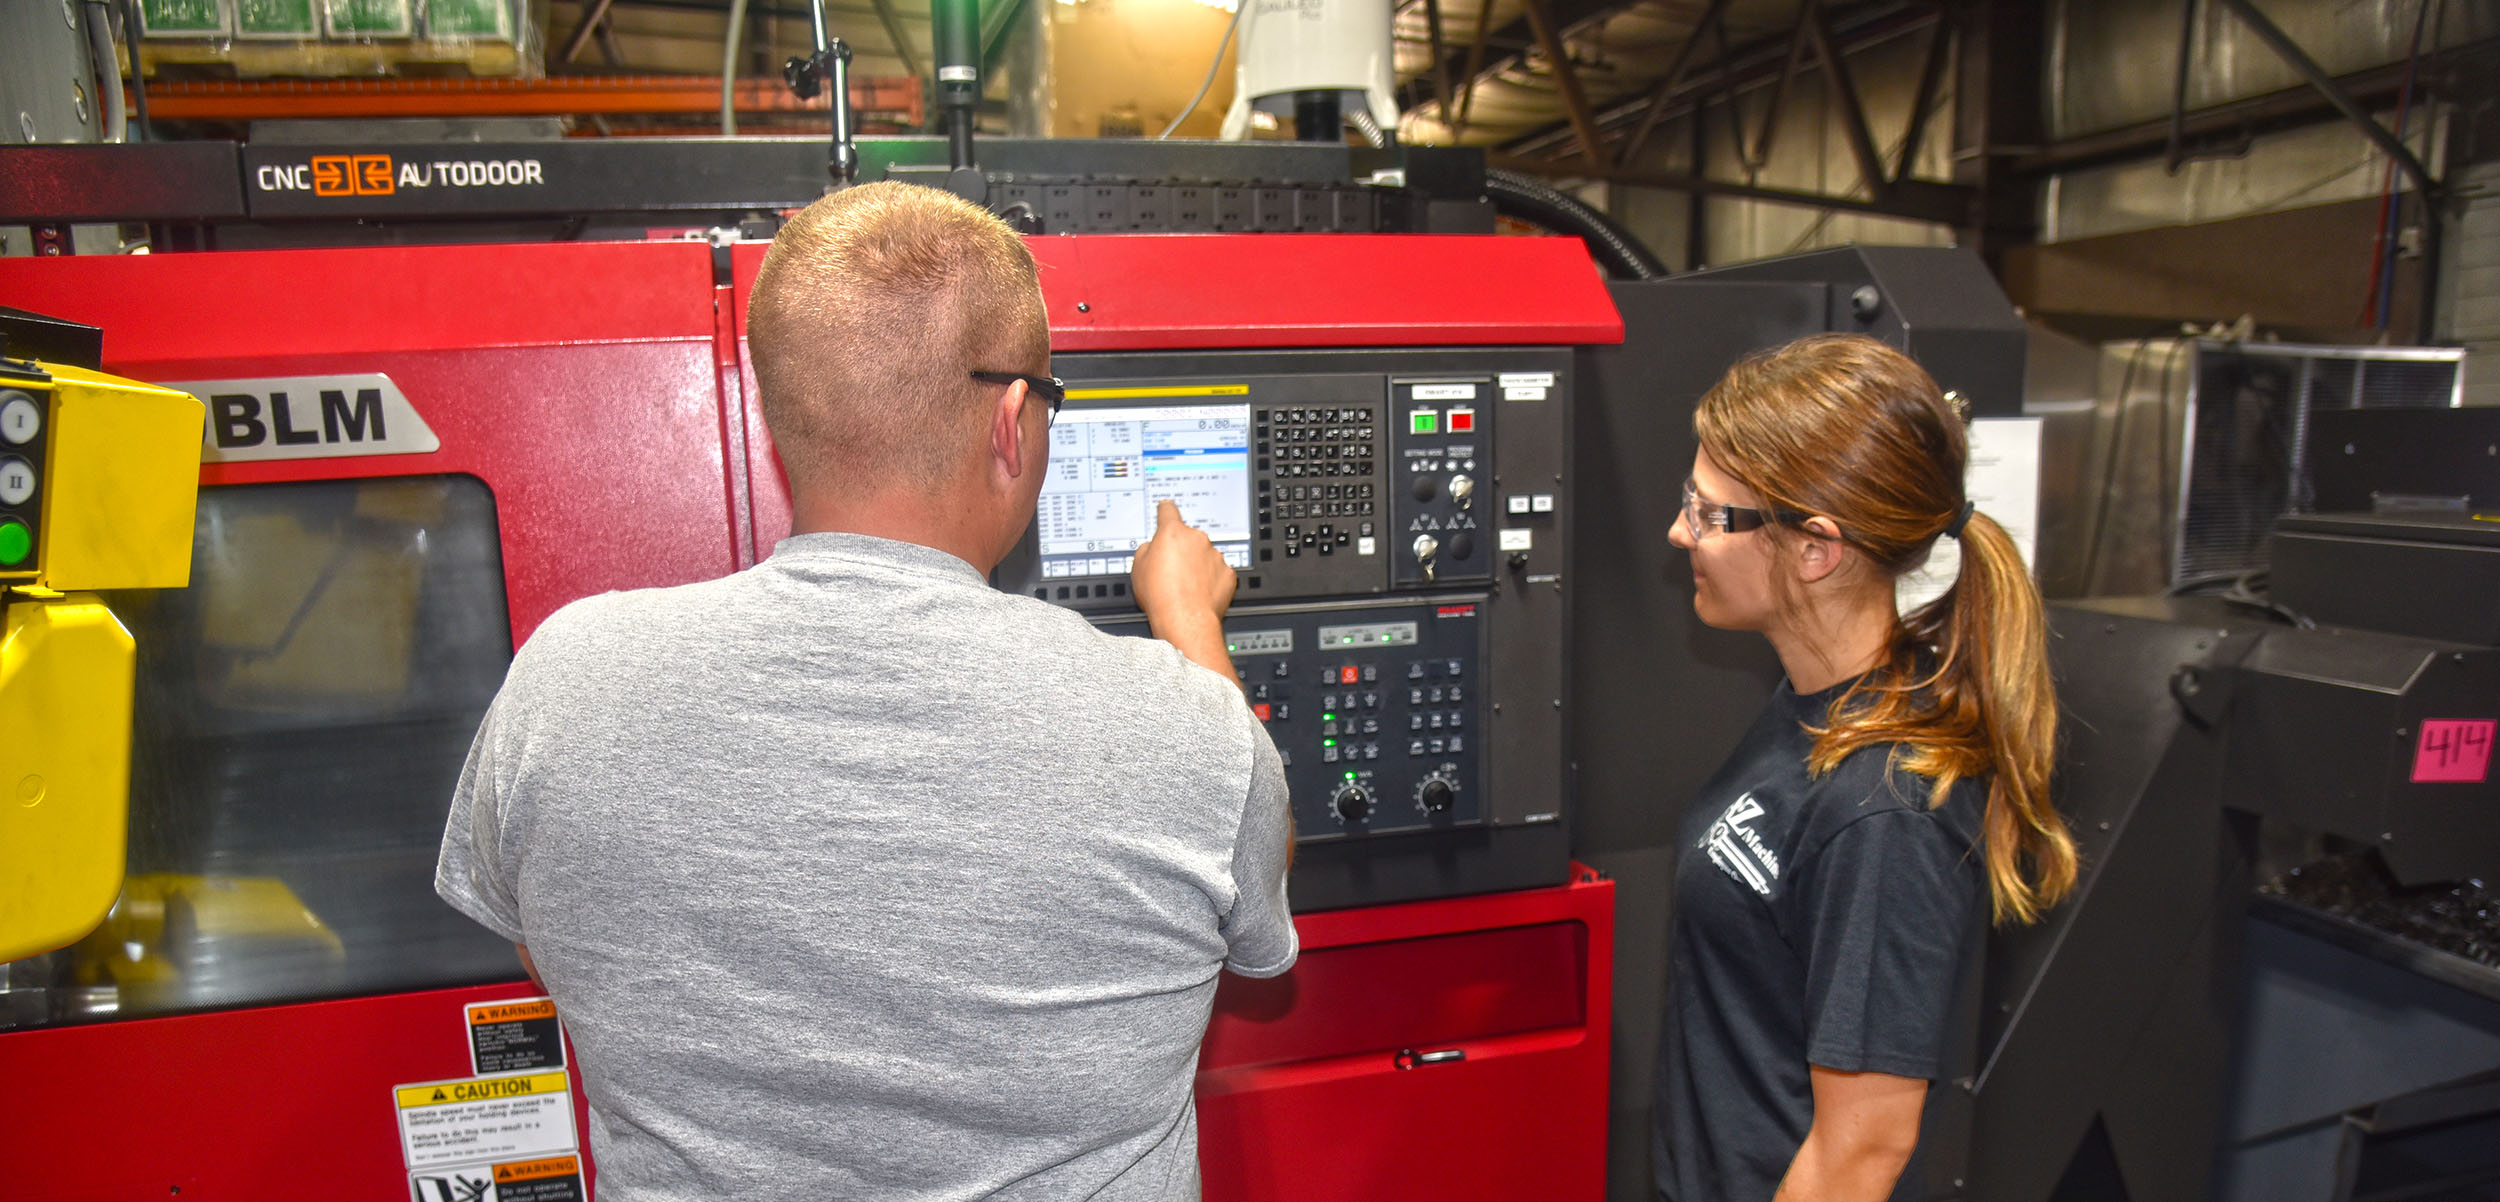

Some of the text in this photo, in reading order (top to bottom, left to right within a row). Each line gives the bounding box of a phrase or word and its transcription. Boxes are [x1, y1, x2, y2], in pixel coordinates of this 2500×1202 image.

[258, 159, 544, 191] CNC AUTODOOR
[203, 388, 387, 449] BLM
[2425, 725, 2487, 768] 414
[1741, 828, 1779, 880] Machin
[489, 1003, 549, 1018] WARNING
[454, 1079, 532, 1100] CAUTION
[513, 1161, 575, 1177] WARNING
